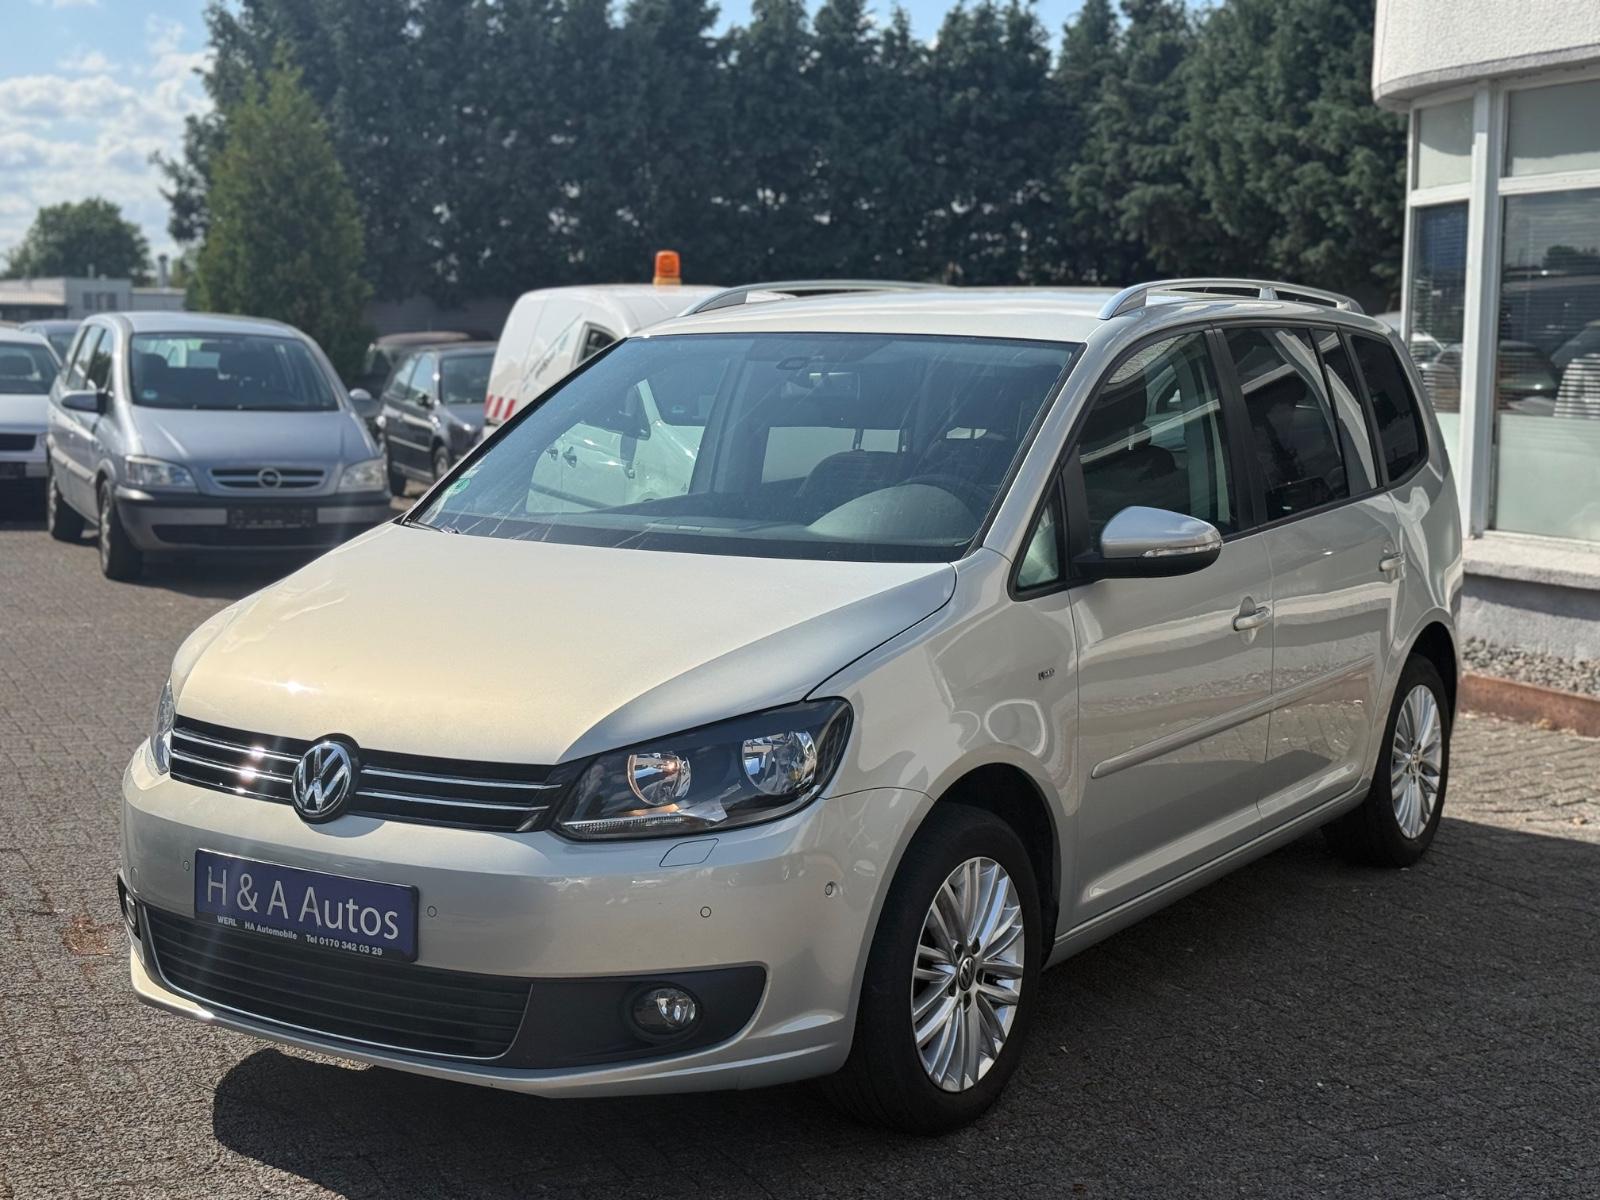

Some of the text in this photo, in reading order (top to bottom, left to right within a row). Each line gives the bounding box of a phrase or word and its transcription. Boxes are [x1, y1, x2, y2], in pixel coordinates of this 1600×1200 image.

[207, 866, 399, 940] H & A Autos
[217, 915, 238, 926] WERL
[244, 921, 255, 931] HA
[256, 924, 298, 940] Automobile
[306, 934, 317, 944] Tel
[319, 937, 340, 948] 0170
[341, 941, 357, 951] 342
[359, 944, 370, 954] 03
